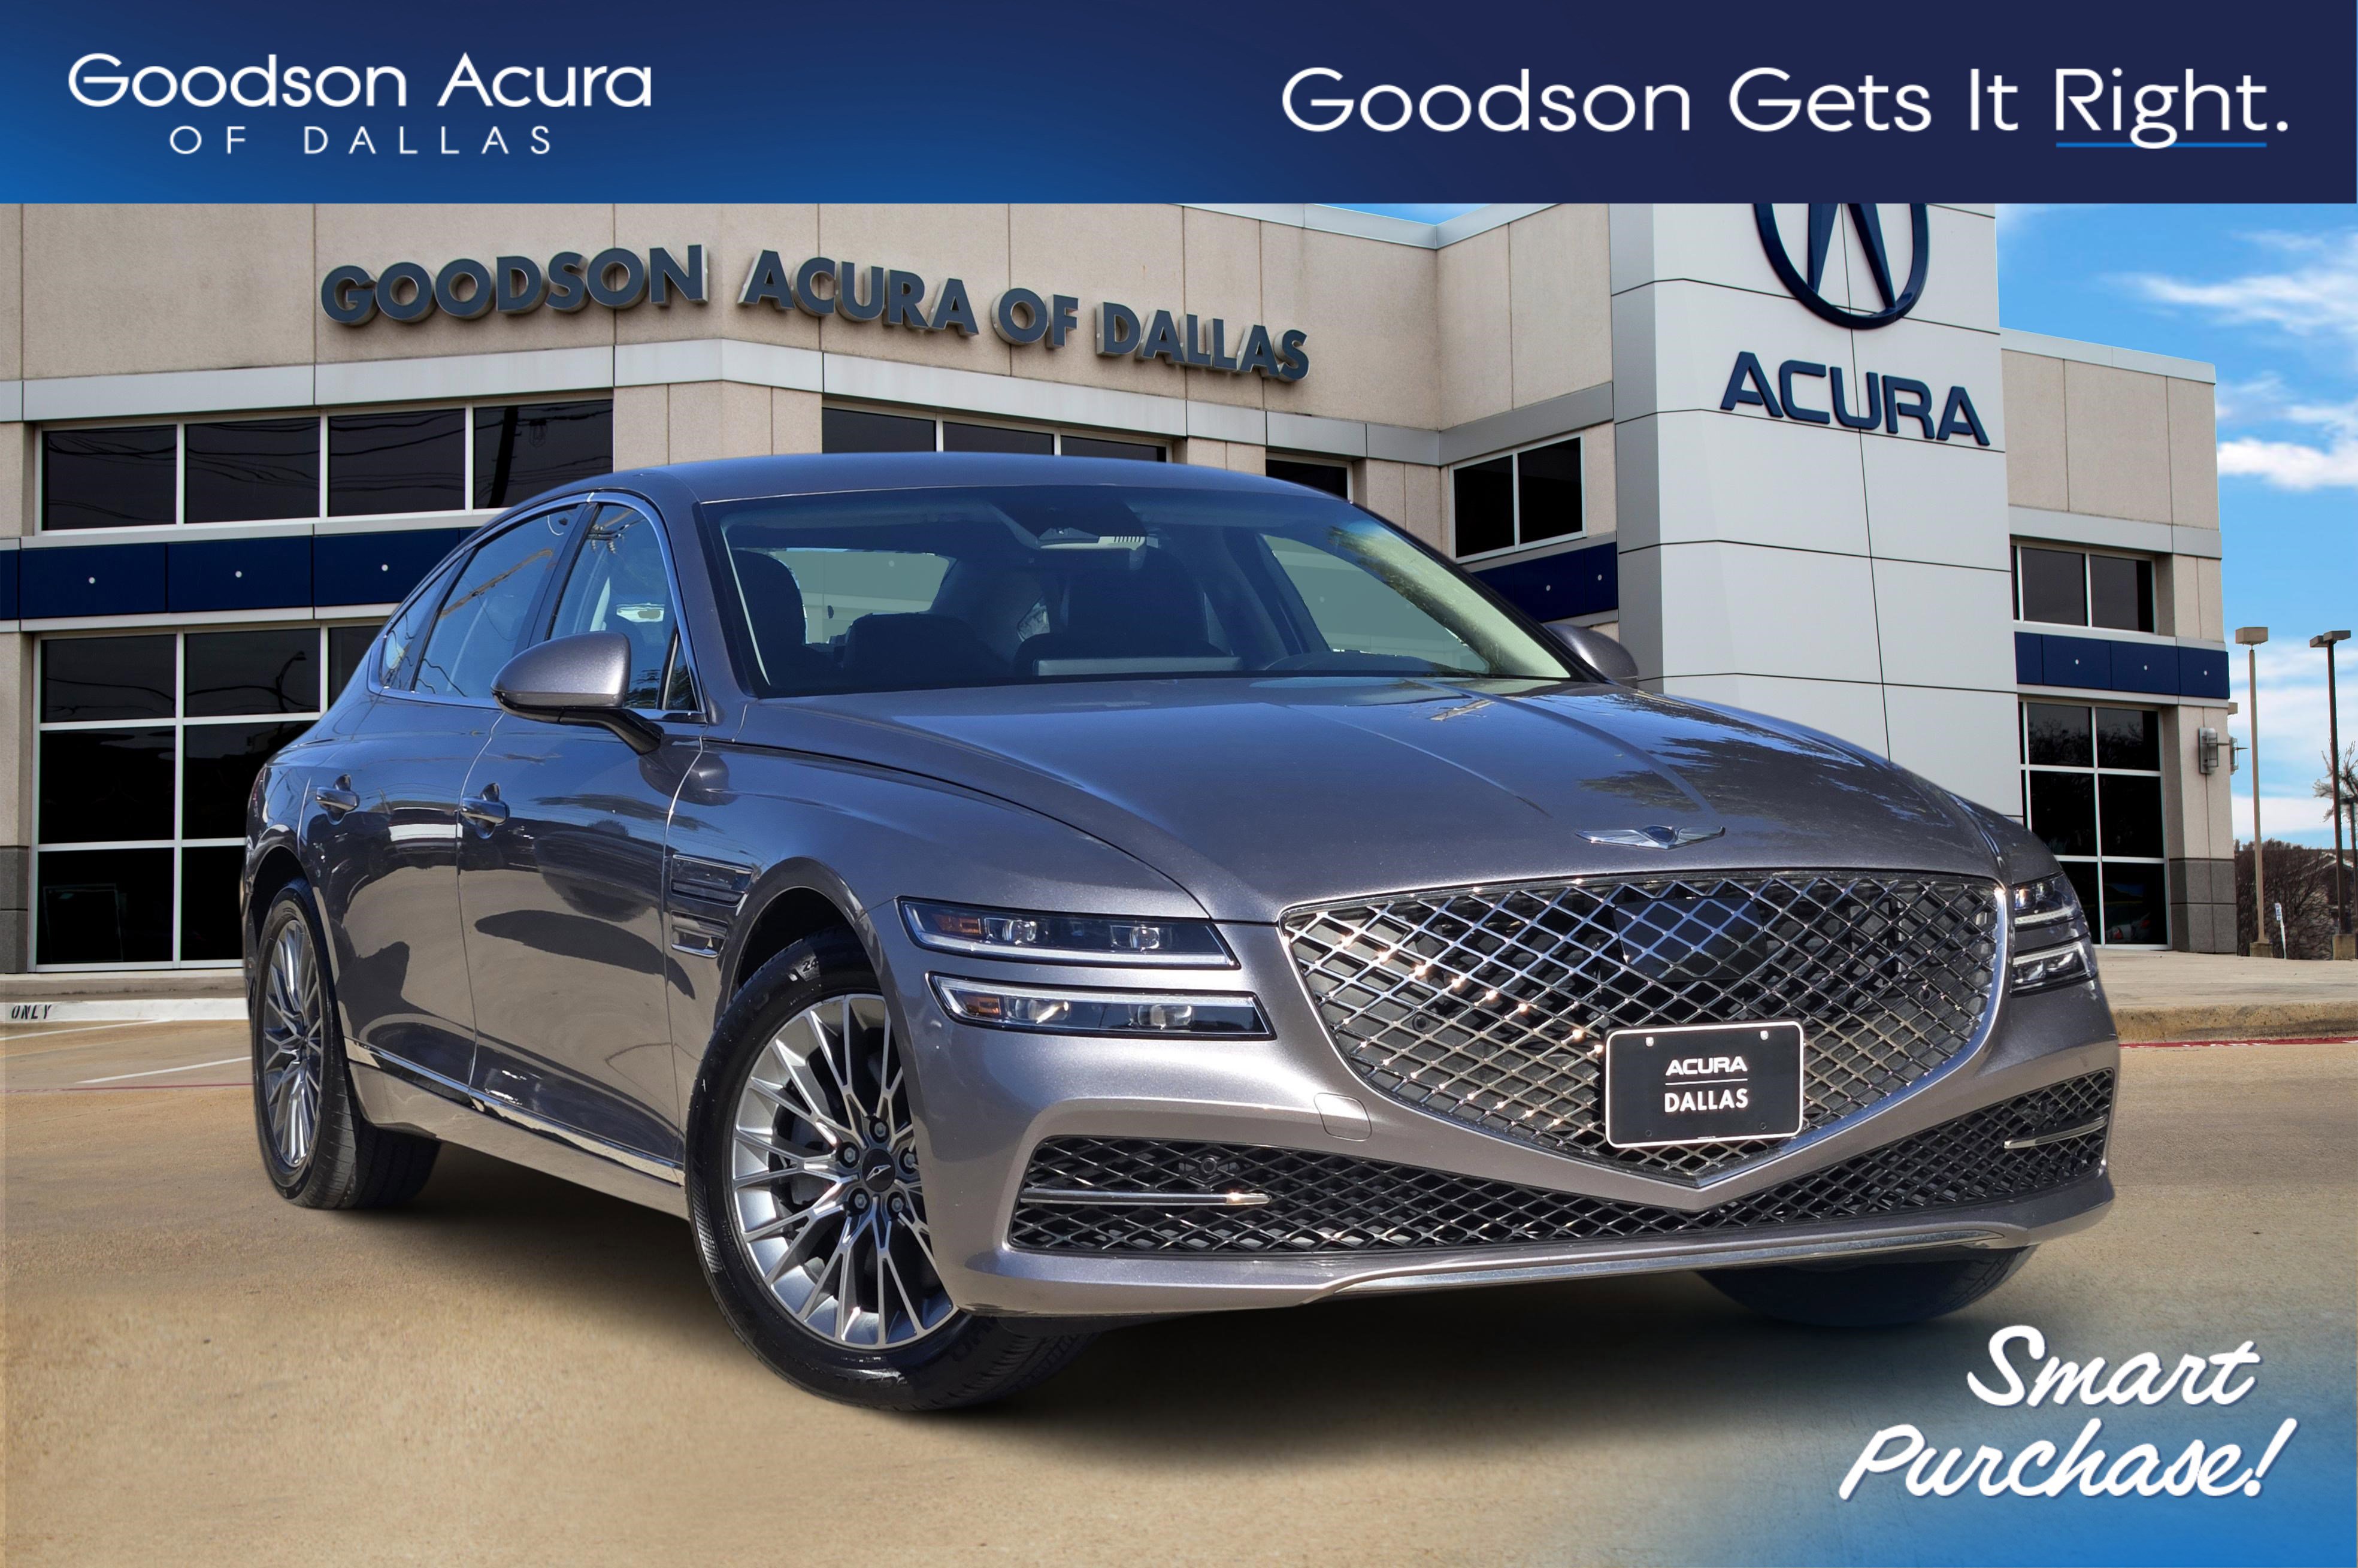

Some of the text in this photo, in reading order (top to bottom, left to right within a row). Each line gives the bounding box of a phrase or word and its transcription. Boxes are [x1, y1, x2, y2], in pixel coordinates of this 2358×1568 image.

[320, 244, 1310, 383] GOODSON ACURA OF DALLAS
[1720, 350, 1991, 446] ACURA
[11, 1004, 52, 1020] ONLY
[1664, 1055, 1749, 1077] ACURA
[1664, 1087, 1749, 1113] DALLAS
